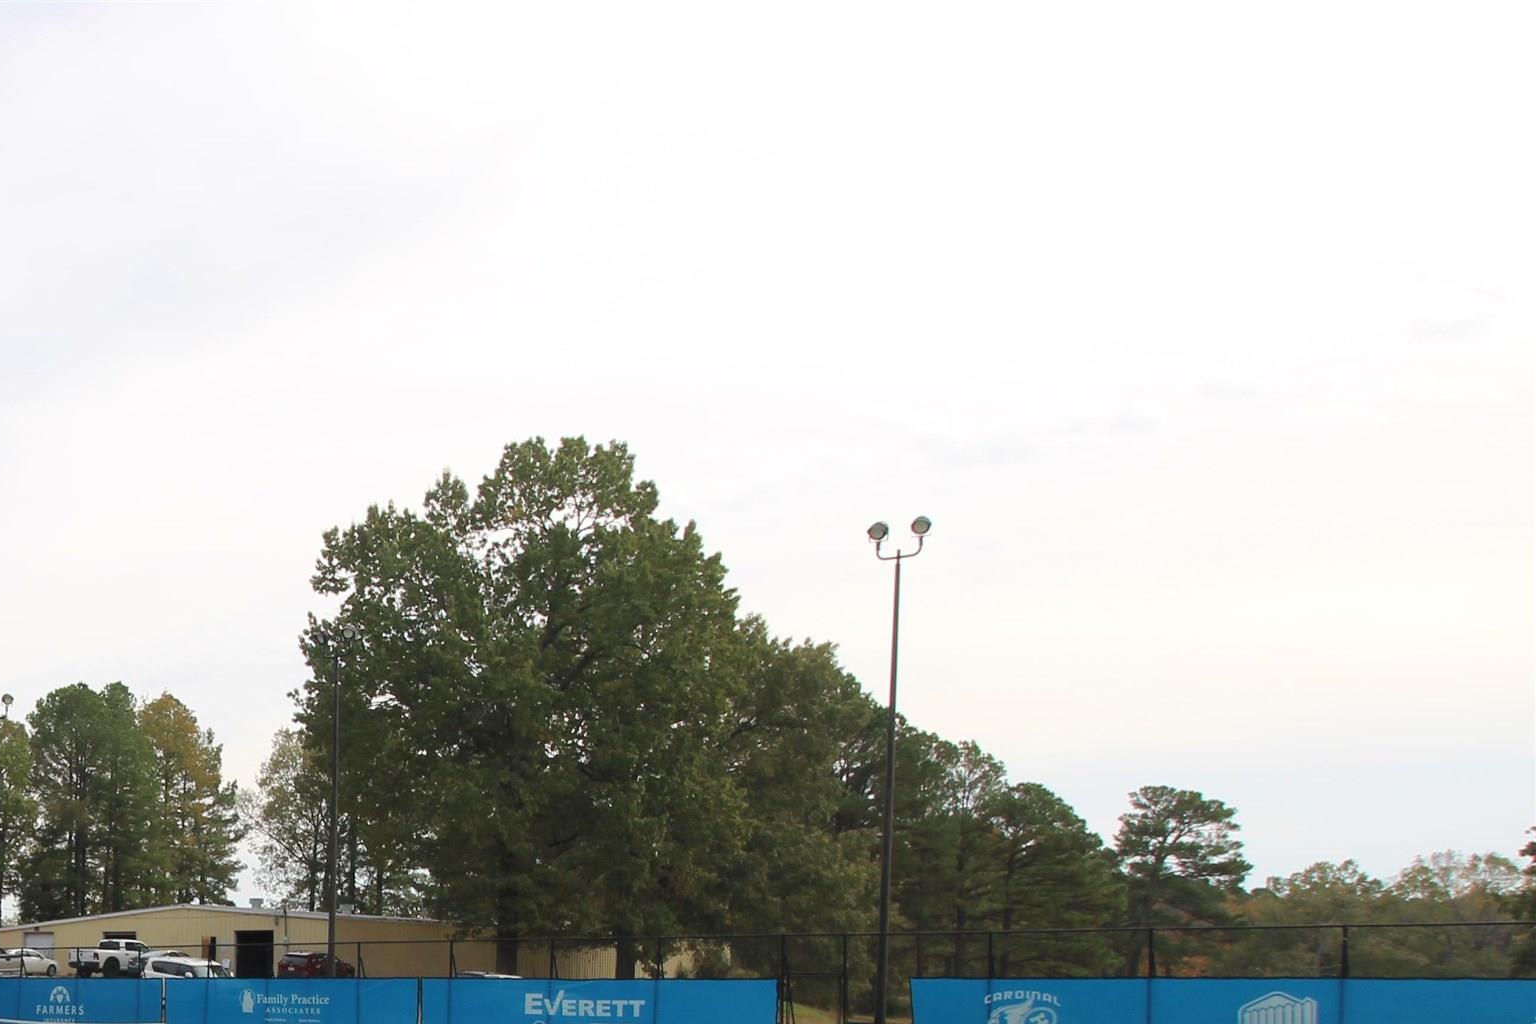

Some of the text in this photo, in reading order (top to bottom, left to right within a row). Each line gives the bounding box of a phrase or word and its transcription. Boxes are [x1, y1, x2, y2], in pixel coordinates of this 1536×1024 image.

[257, 994, 330, 1006] Family Practice
[525, 990, 645, 1017] EVERETT
[984, 990, 1061, 1006] CARDINAL
[36, 1005, 84, 1015] FARMERS
